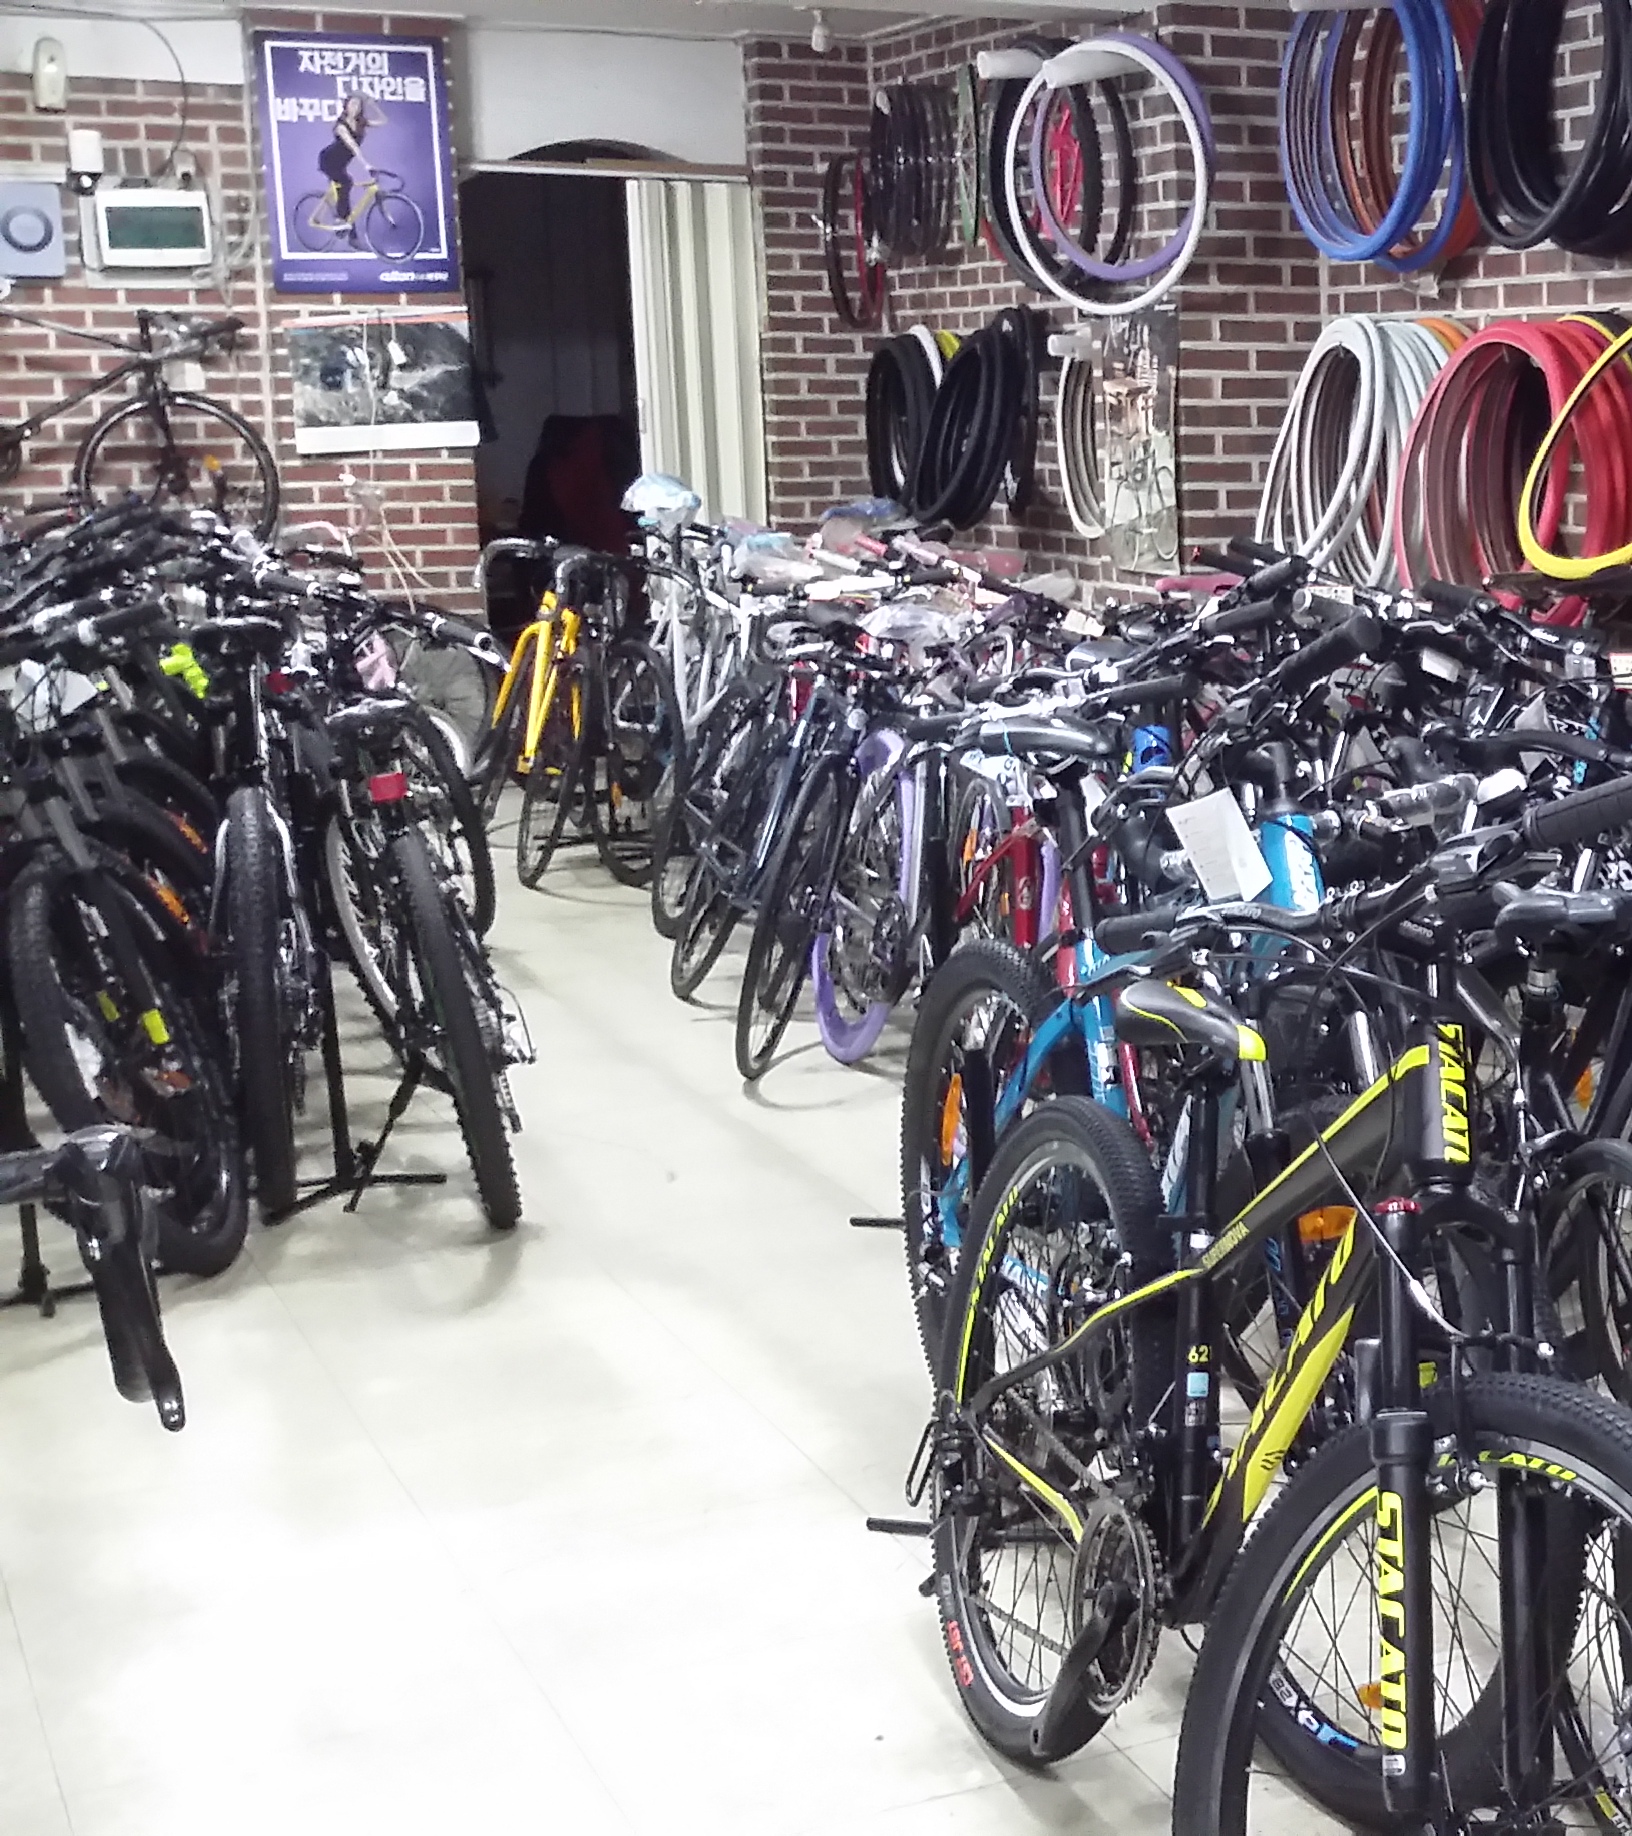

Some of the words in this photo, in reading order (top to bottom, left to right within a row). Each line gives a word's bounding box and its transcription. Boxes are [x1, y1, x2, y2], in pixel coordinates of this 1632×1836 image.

[298, 50, 389, 75] 자전거의
[336, 76, 427, 102] 디자인을
[1376, 1491, 1407, 1750] STACATO
